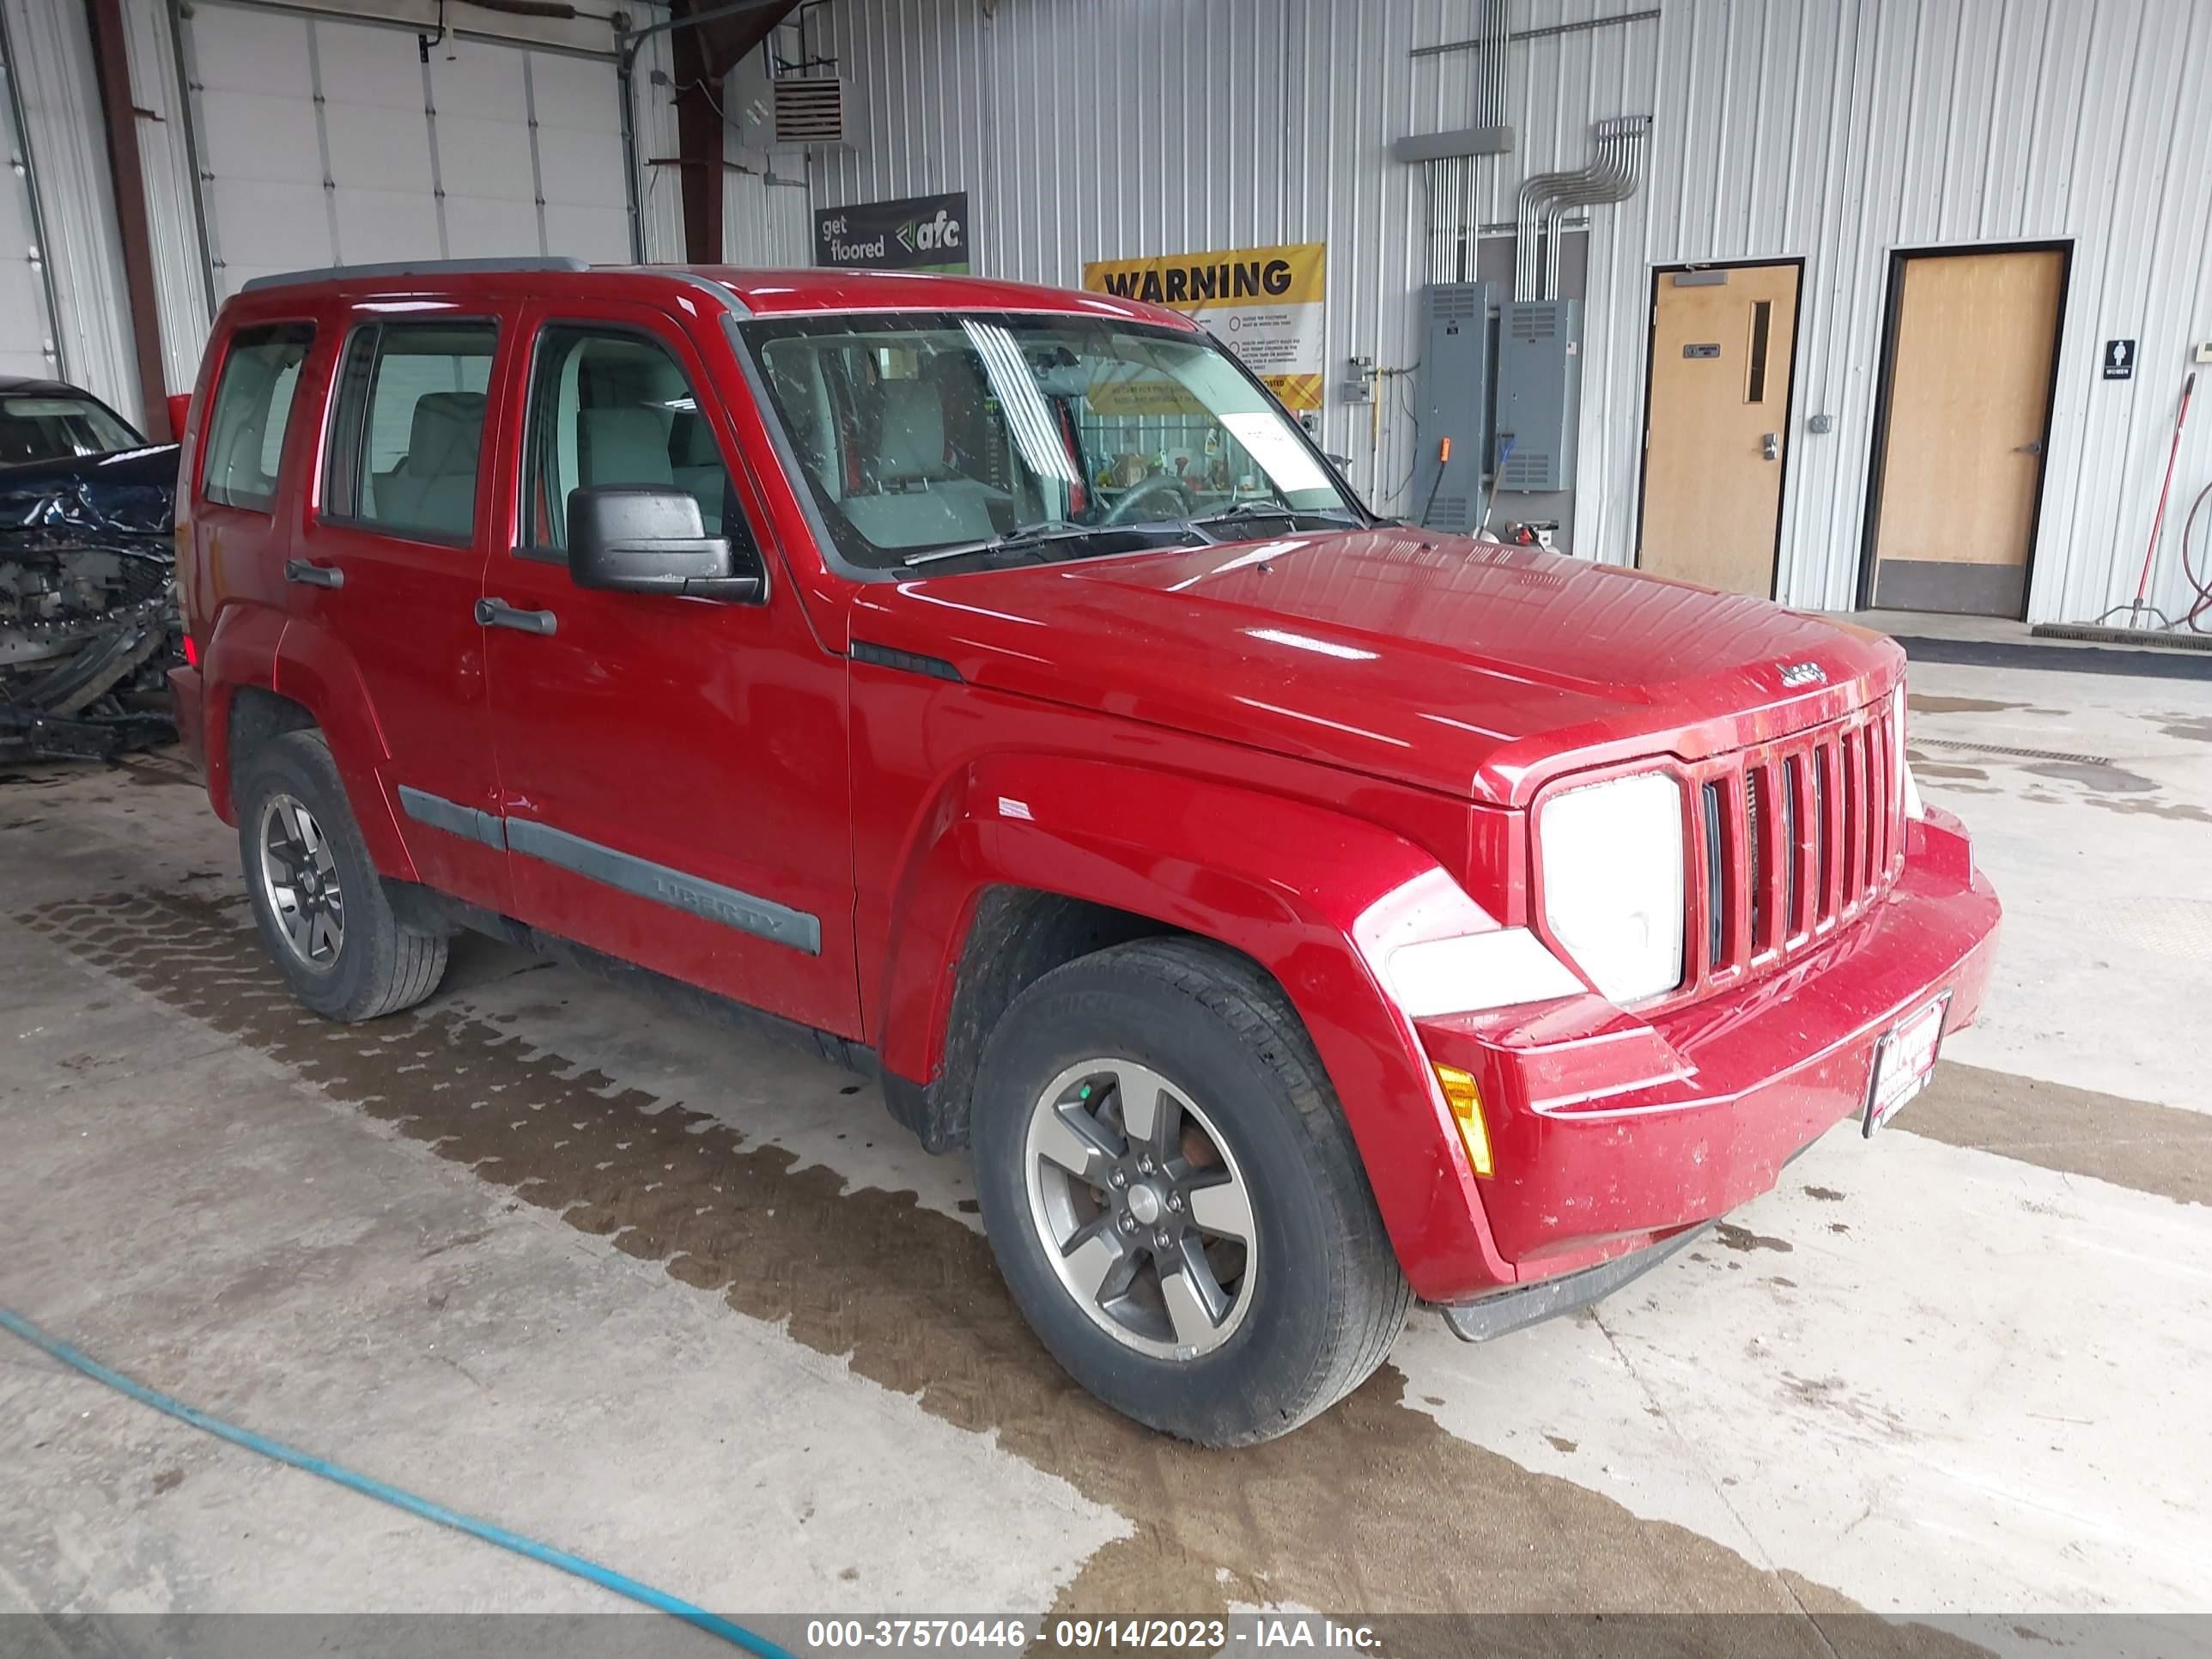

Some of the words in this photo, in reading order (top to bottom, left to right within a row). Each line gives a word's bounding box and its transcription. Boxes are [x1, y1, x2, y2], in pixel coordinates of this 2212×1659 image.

[823, 215, 848, 240] get
[830, 234, 885, 262] floored
[916, 210, 961, 251] afc
[1104, 259, 1291, 303] WARNING
[653, 878, 783, 933] LIBERTY
